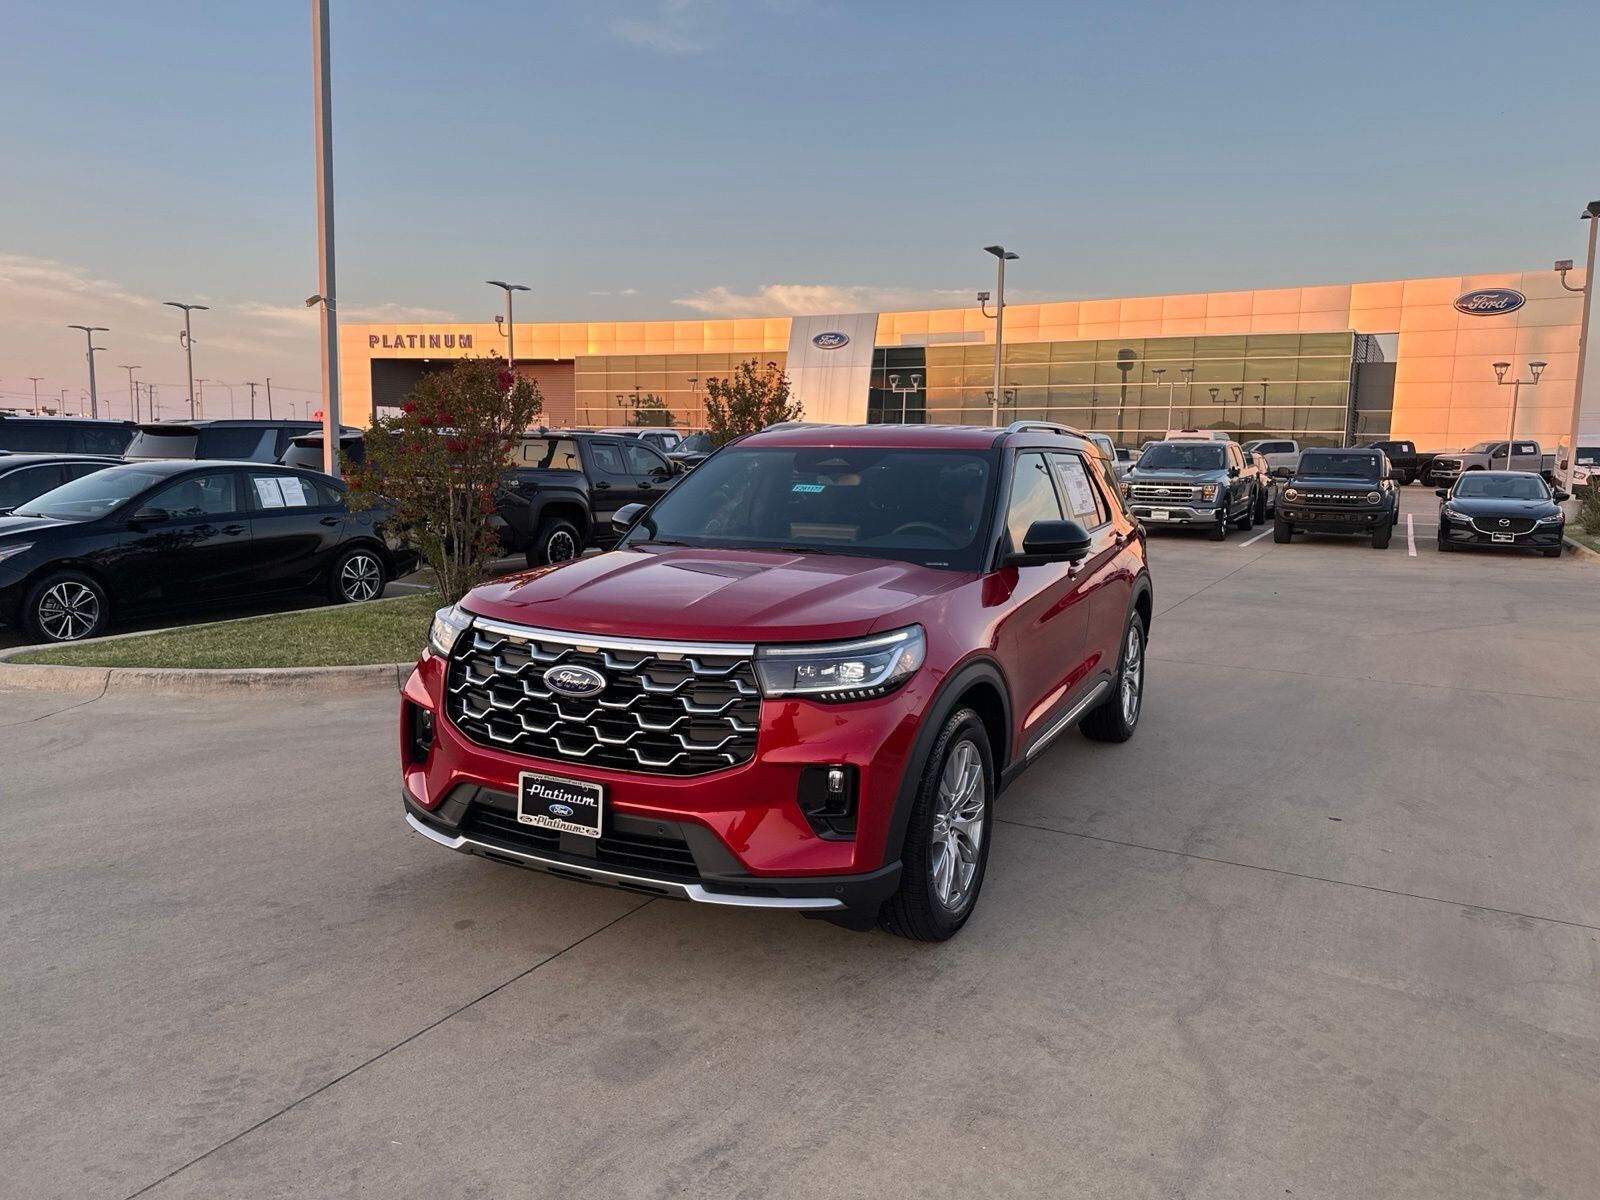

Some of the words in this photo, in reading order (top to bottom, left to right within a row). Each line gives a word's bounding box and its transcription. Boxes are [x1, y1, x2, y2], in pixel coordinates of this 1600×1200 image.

[369, 334, 473, 349] PLATINUM
[556, 671, 590, 690] Ford
[526, 784, 598, 807] Platinum
[536, 816, 585, 834] Platinum
